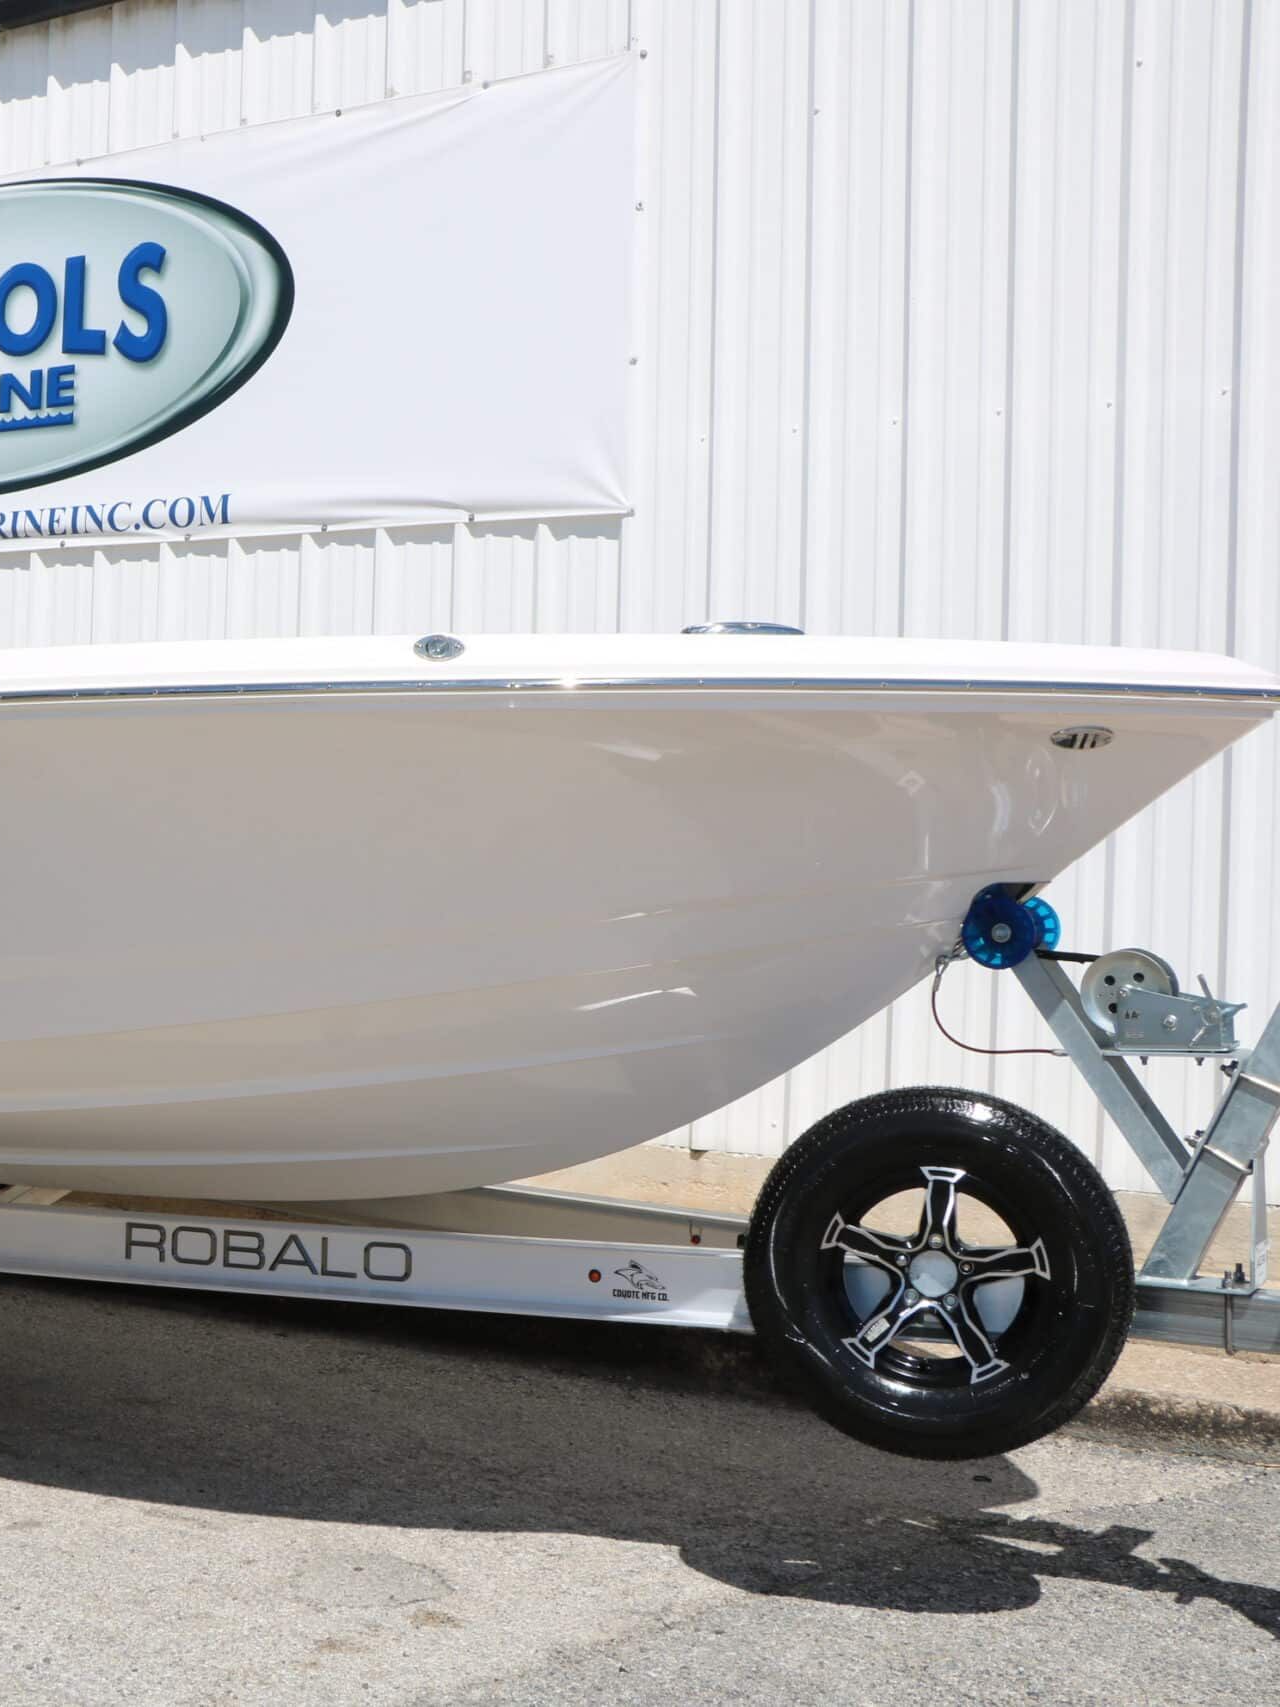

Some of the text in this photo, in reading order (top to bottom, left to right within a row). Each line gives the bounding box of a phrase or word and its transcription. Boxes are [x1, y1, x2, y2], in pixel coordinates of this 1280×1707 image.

[124, 1221, 413, 1283] ROBALO
[612, 1288, 640, 1300] COYOTE
[641, 1291, 656, 1301] MFG
